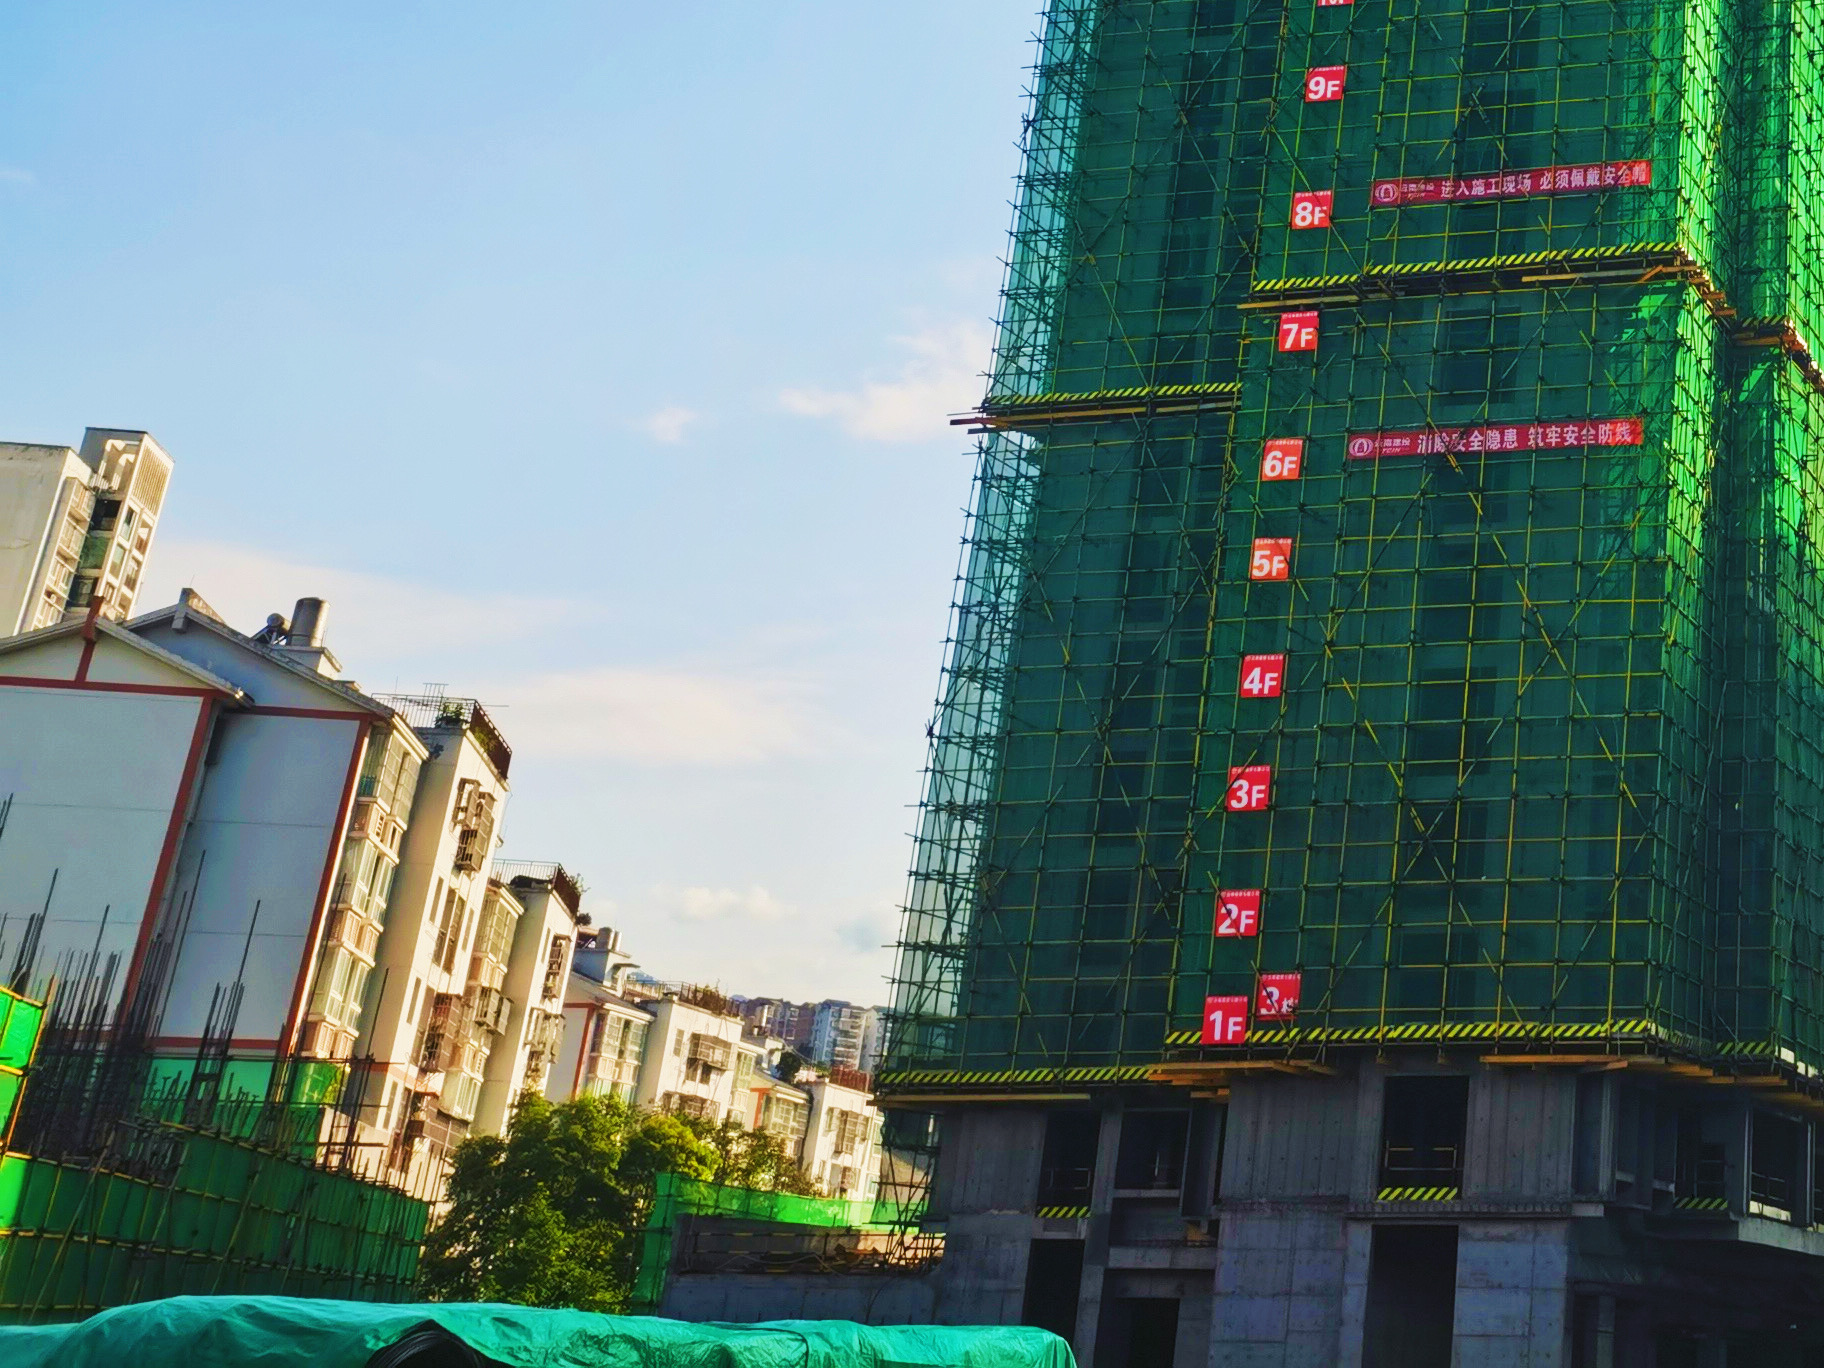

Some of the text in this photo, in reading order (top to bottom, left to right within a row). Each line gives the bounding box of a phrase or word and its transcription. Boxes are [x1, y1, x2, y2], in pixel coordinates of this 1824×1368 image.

[1309, 76, 1341, 100] 9F
[1295, 201, 1328, 227] 8F
[1282, 323, 1315, 349] 7F
[1264, 450, 1298, 477] 6F
[1252, 550, 1286, 577] 5F
[1243, 666, 1279, 695] 4F
[1230, 779, 1266, 809] 3F
[1218, 903, 1256, 934] 2F
[1209, 1010, 1243, 1041] 1F
